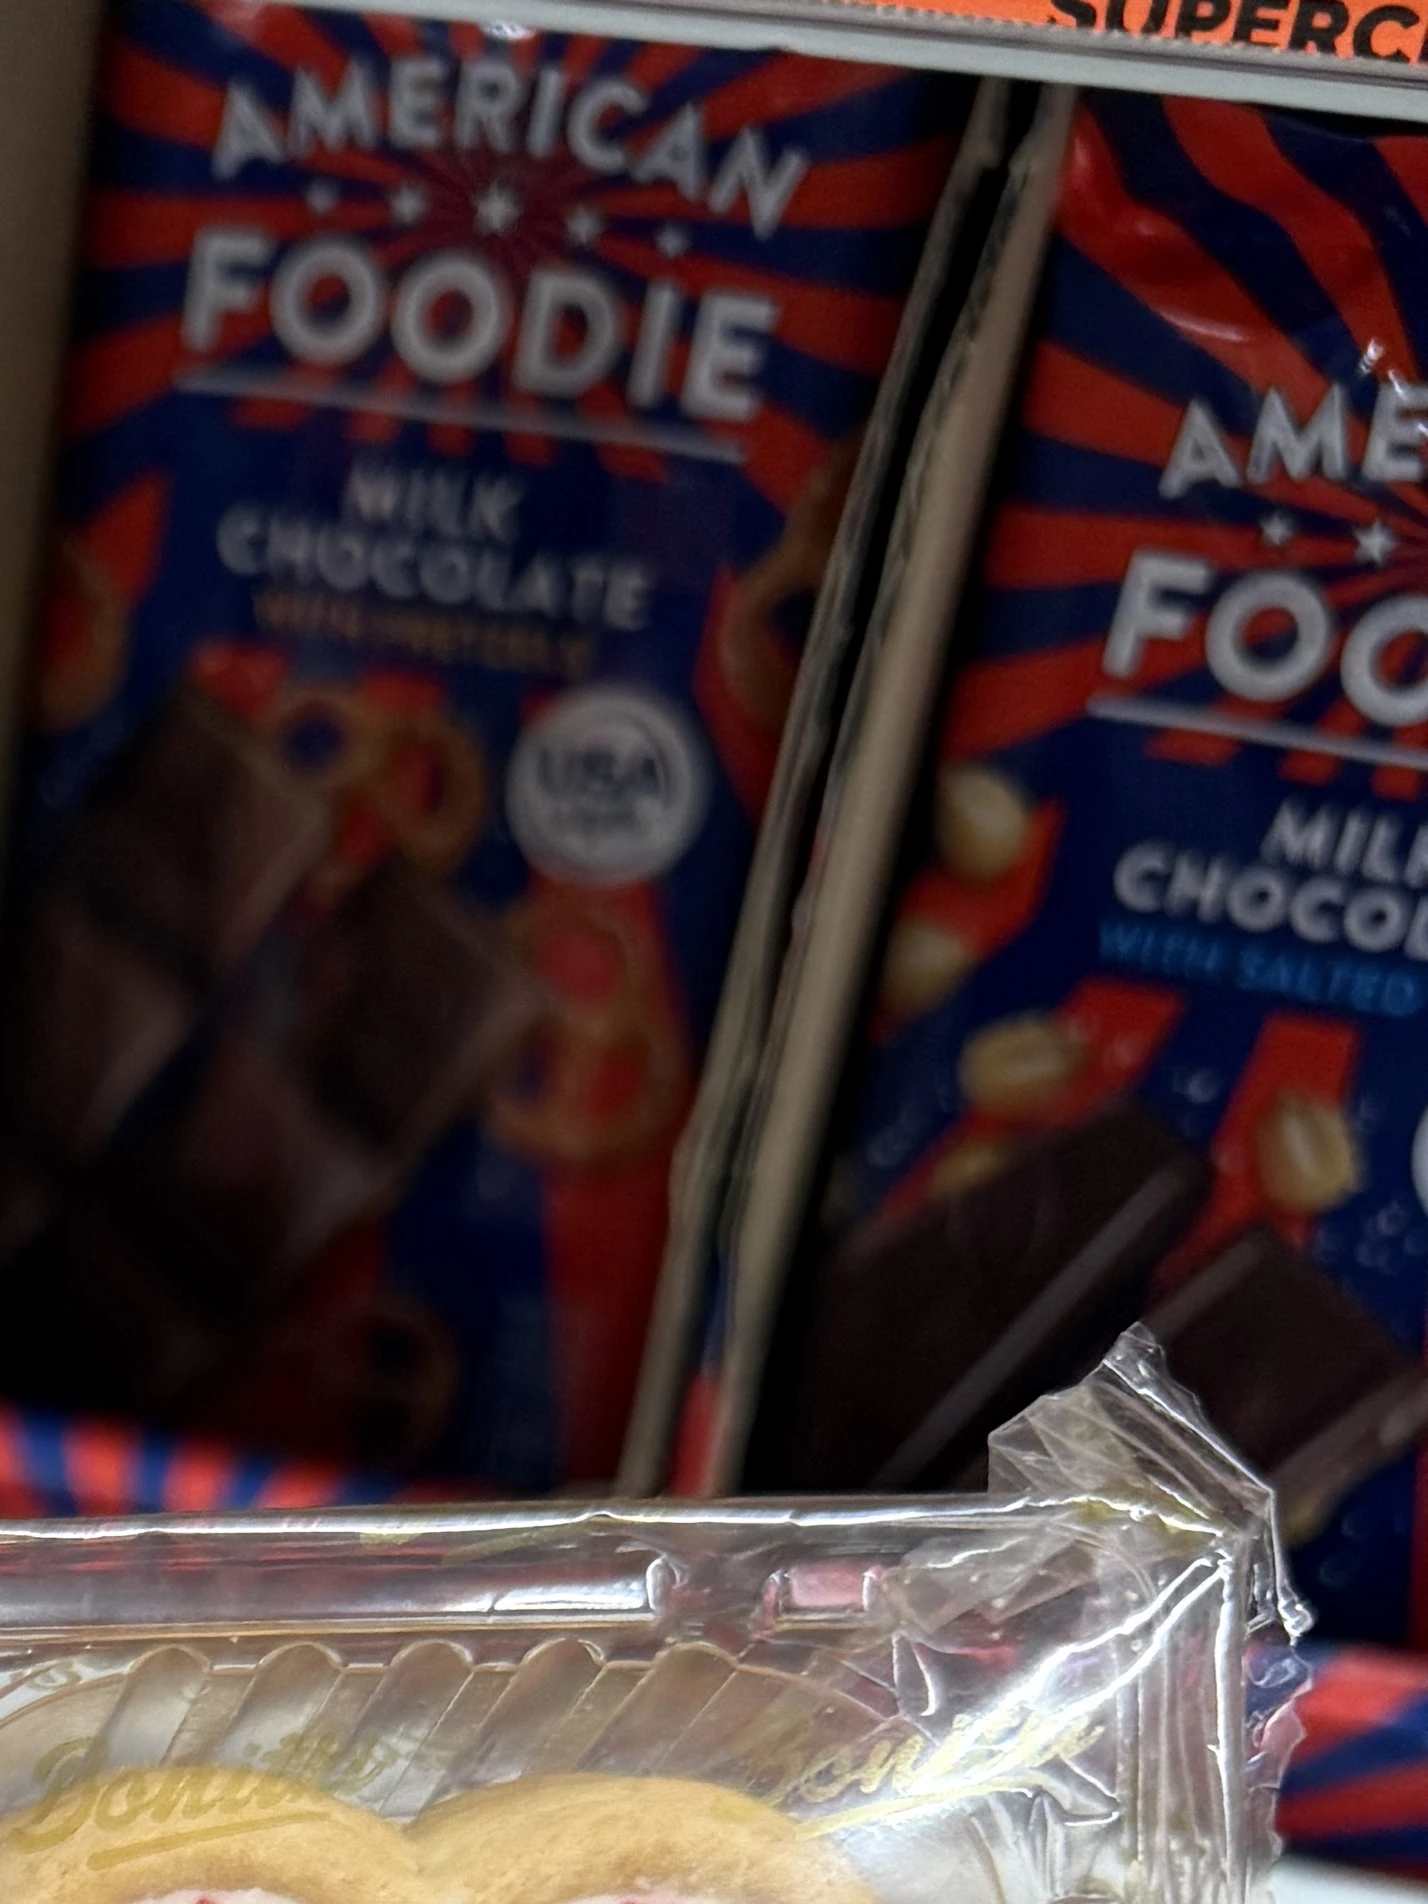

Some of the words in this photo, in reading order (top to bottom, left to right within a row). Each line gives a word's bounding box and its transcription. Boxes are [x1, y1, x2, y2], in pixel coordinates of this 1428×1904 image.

[1047, 0, 1428, 63] UPERC
[211, 56, 807, 240] AMERICAN
[180, 227, 781, 424] FOODIE
[215, 498, 657, 632] CHOCOLATE
[342, 457, 526, 540] MILK
